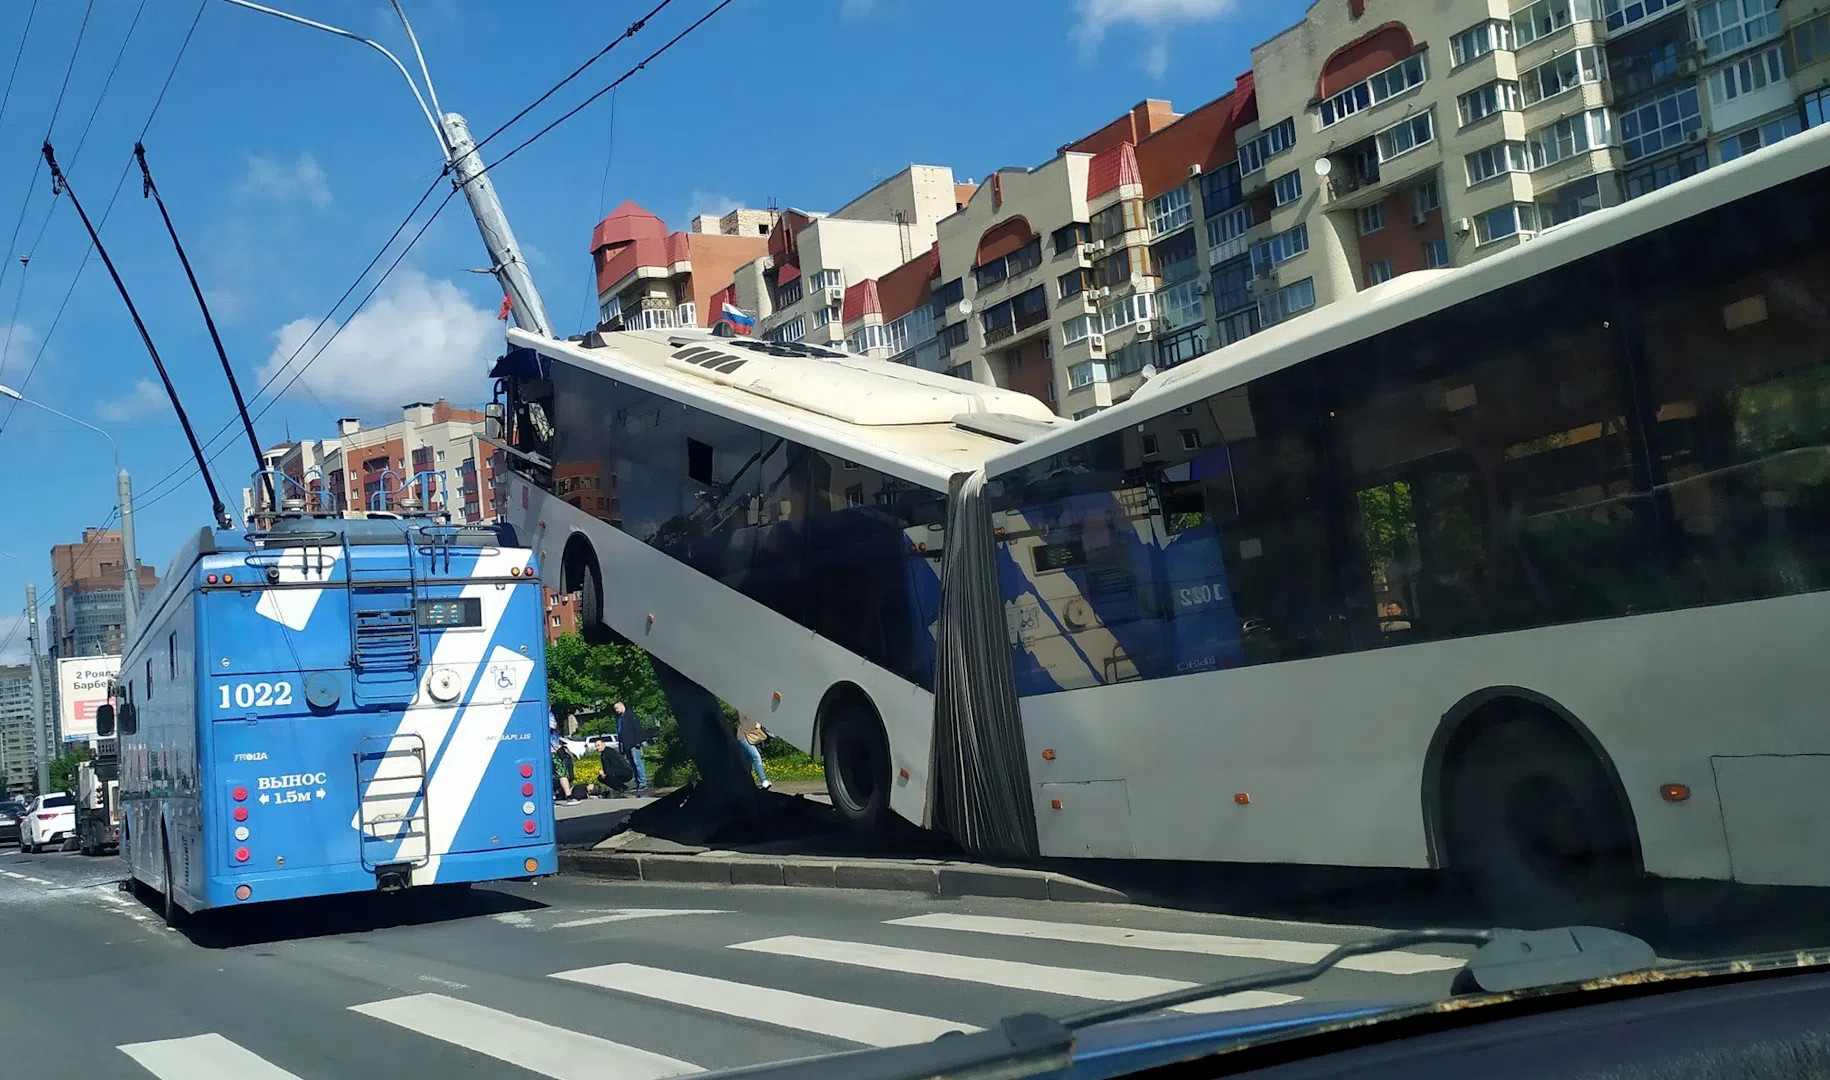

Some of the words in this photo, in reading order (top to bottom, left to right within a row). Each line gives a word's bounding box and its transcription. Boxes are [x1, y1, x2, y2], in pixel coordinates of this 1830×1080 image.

[75, 671, 83, 680] 2
[85, 669, 116, 679] Роял
[73, 680, 114, 691] Барбек
[218, 681, 293, 709] 1022
[257, 772, 327, 790] ВЫНОС
